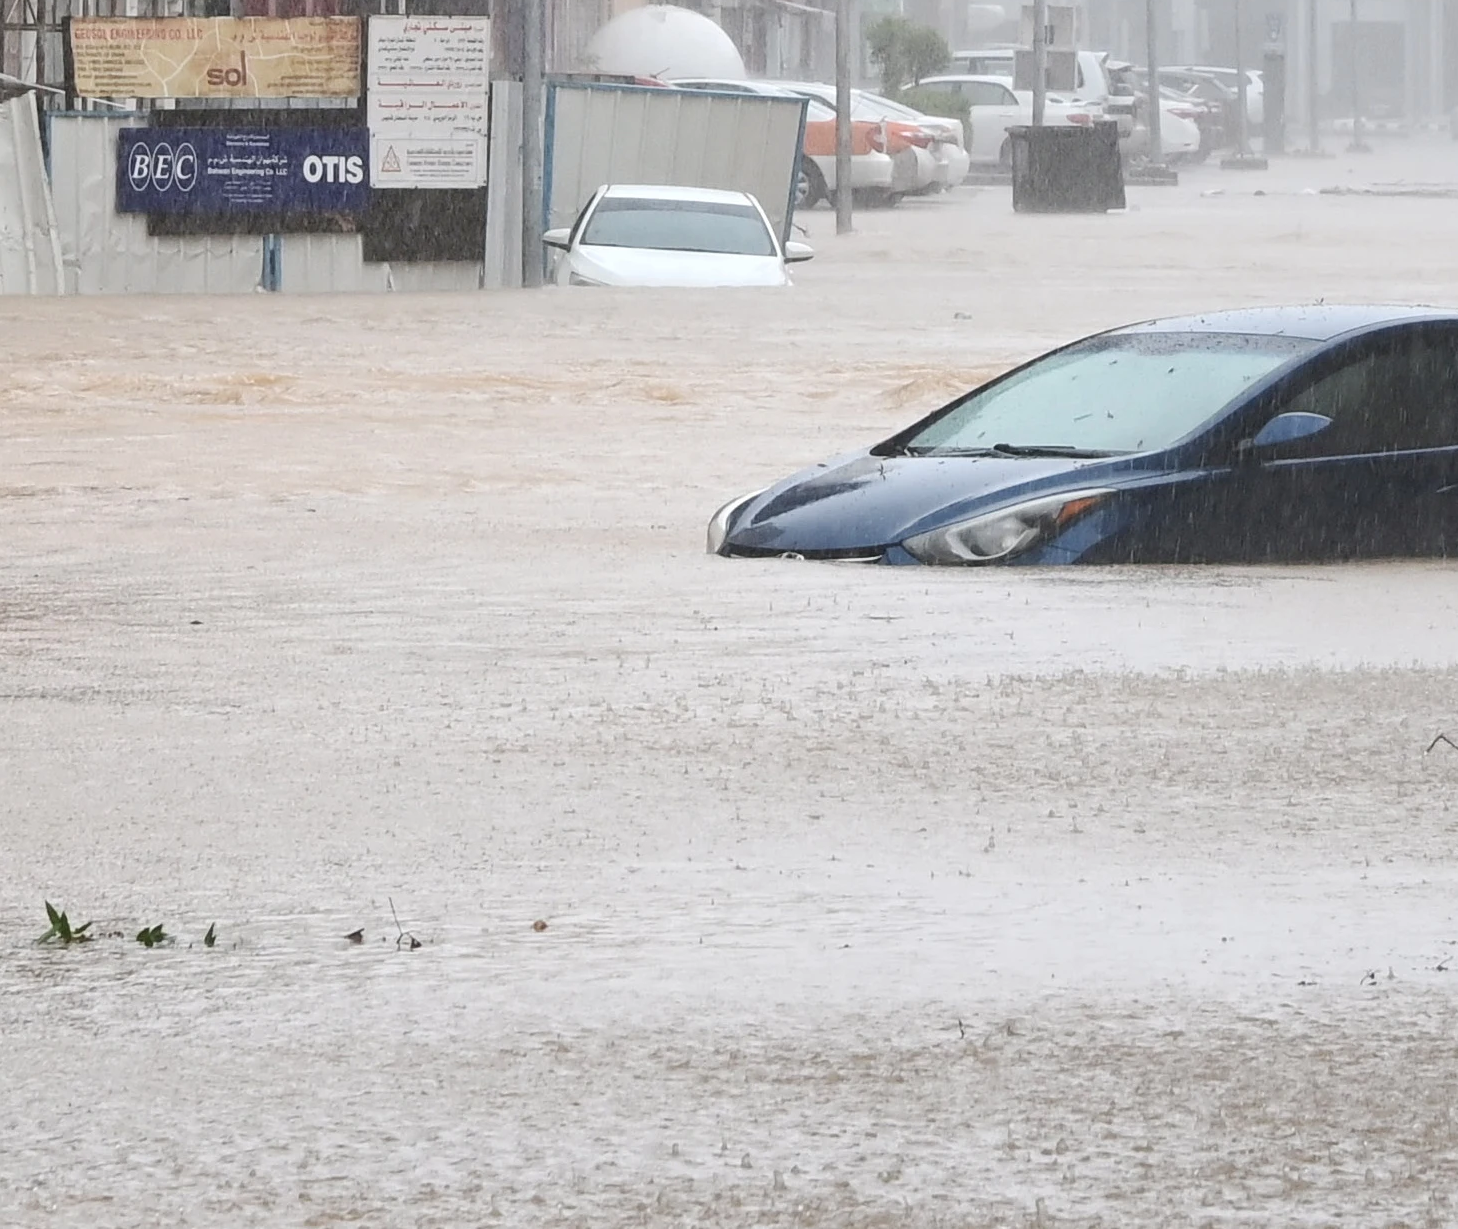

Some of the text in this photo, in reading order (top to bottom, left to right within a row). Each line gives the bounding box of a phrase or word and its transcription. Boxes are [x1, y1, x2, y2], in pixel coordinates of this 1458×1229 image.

[110, 28, 166, 40] ENGINEERING
[207, 50, 247, 86] sol
[231, 167, 265, 177] Engineering
[275, 167, 288, 176] LLC
[303, 155, 363, 183] OTIS
